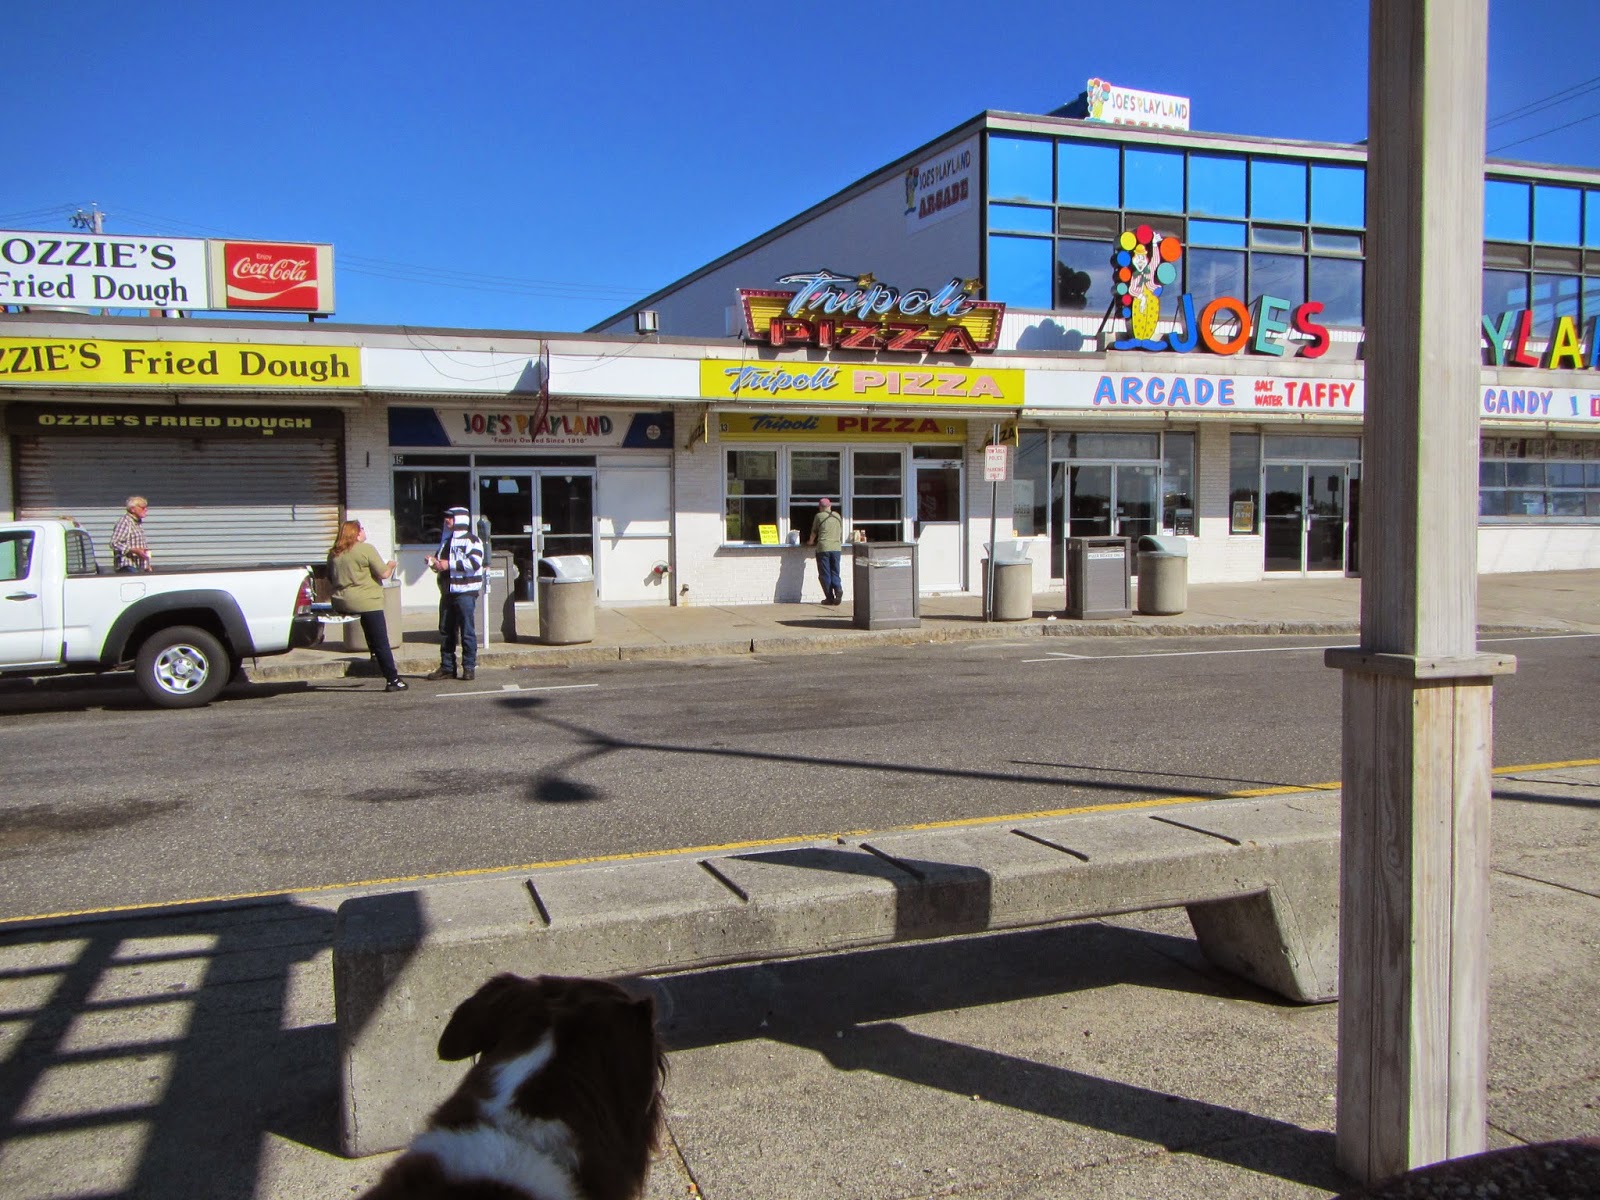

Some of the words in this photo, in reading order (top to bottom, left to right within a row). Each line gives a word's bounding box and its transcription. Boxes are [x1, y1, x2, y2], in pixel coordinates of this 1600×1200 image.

[1137, 97, 1188, 120] PLAYLAND
[935, 149, 971, 182] PLAYLAND
[919, 177, 969, 219] ARCADE
[2, 238, 177, 270] OZZIE'S
[233, 256, 311, 281] Coca-Cola
[256, 252, 273, 261] Enjoy
[92, 275, 189, 307] Dough
[775, 268, 976, 320] Tripoli
[769, 317, 978, 354] PIZZA
[1169, 292, 1331, 358] JOES
[1482, 310, 1600, 370] YLA
[123, 348, 218, 376] Fried
[239, 350, 350, 383] Dough
[724, 365, 838, 395] Tripoli
[852, 370, 1004, 399] PIZZA
[1093, 375, 1236, 406] ARCADE
[1254, 380, 1275, 393] SALT
[1254, 394, 1284, 407] WATER
[1284, 381, 1356, 408] TAFFY
[1484, 388, 1554, 415] CANDY
[38, 414, 140, 426] OZZIE'S
[145, 415, 221, 428] FRIED
[226, 417, 312, 429] DOUGH
[515, 414, 614, 437] PAYLAND
[750, 415, 820, 432] Tripoli
[836, 417, 940, 433] PIZZA
[946, 426, 955, 435] 13
